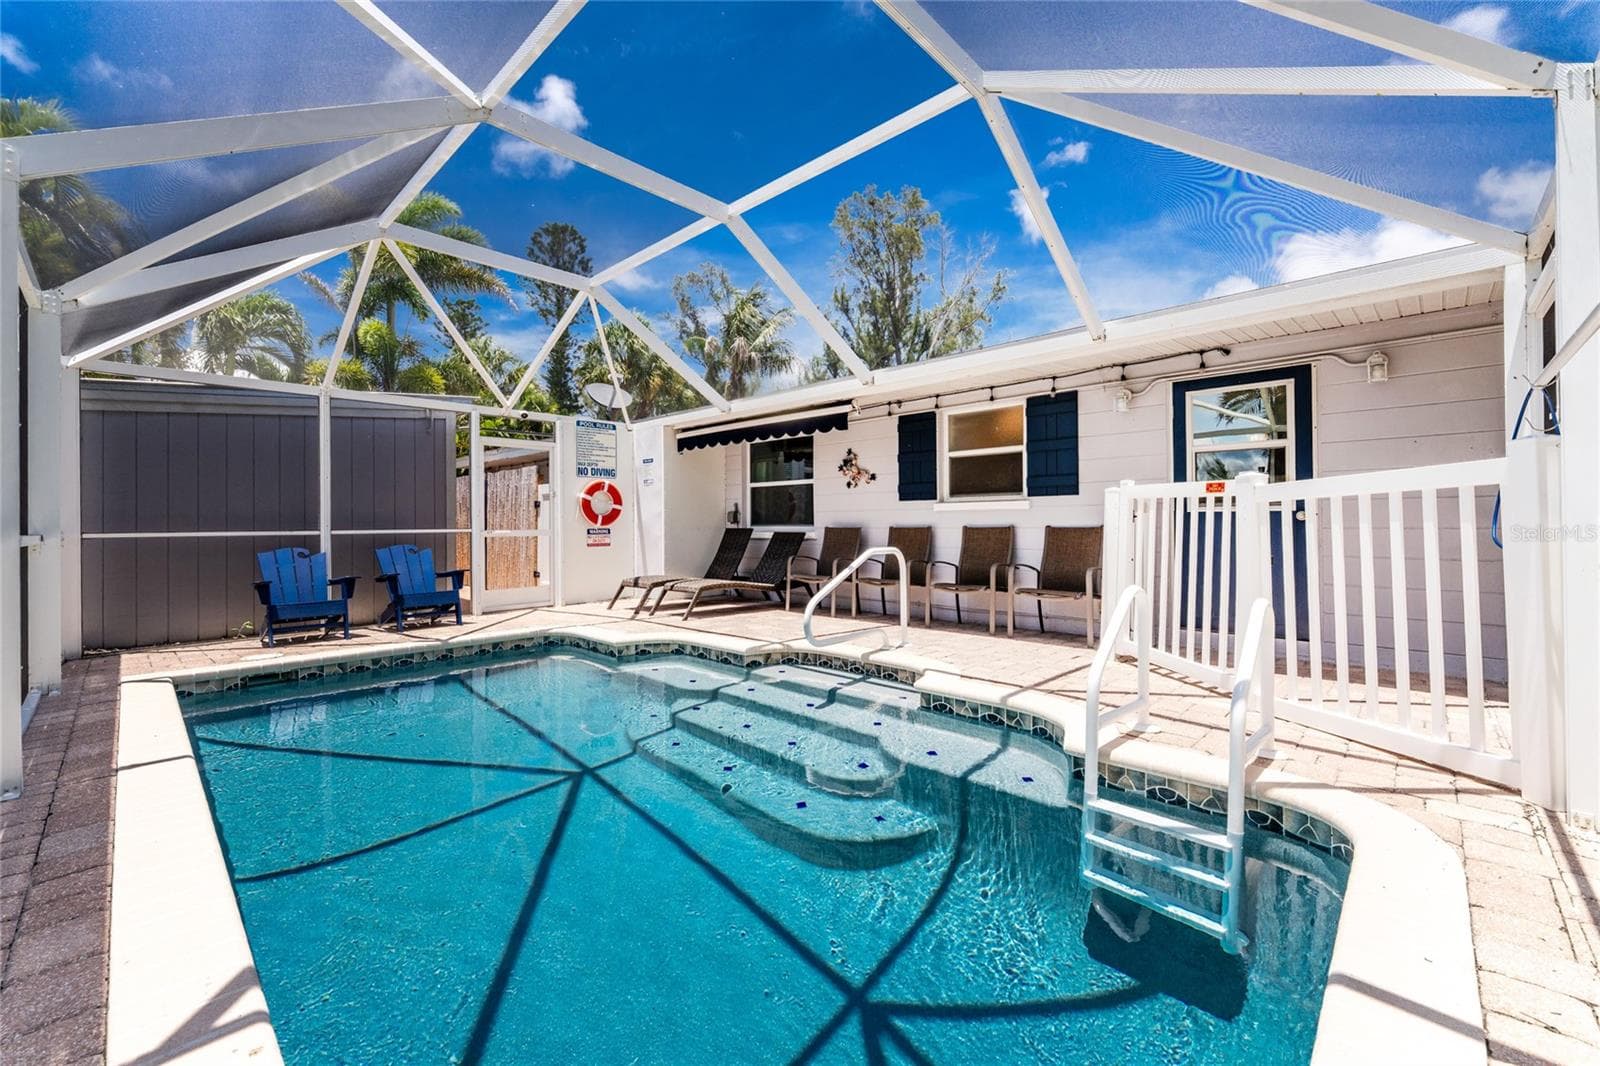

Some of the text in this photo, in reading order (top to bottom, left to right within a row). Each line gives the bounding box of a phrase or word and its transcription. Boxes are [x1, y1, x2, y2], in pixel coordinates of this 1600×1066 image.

[579, 420, 614, 430] POOL RULES
[577, 467, 616, 477] NO DIVING
